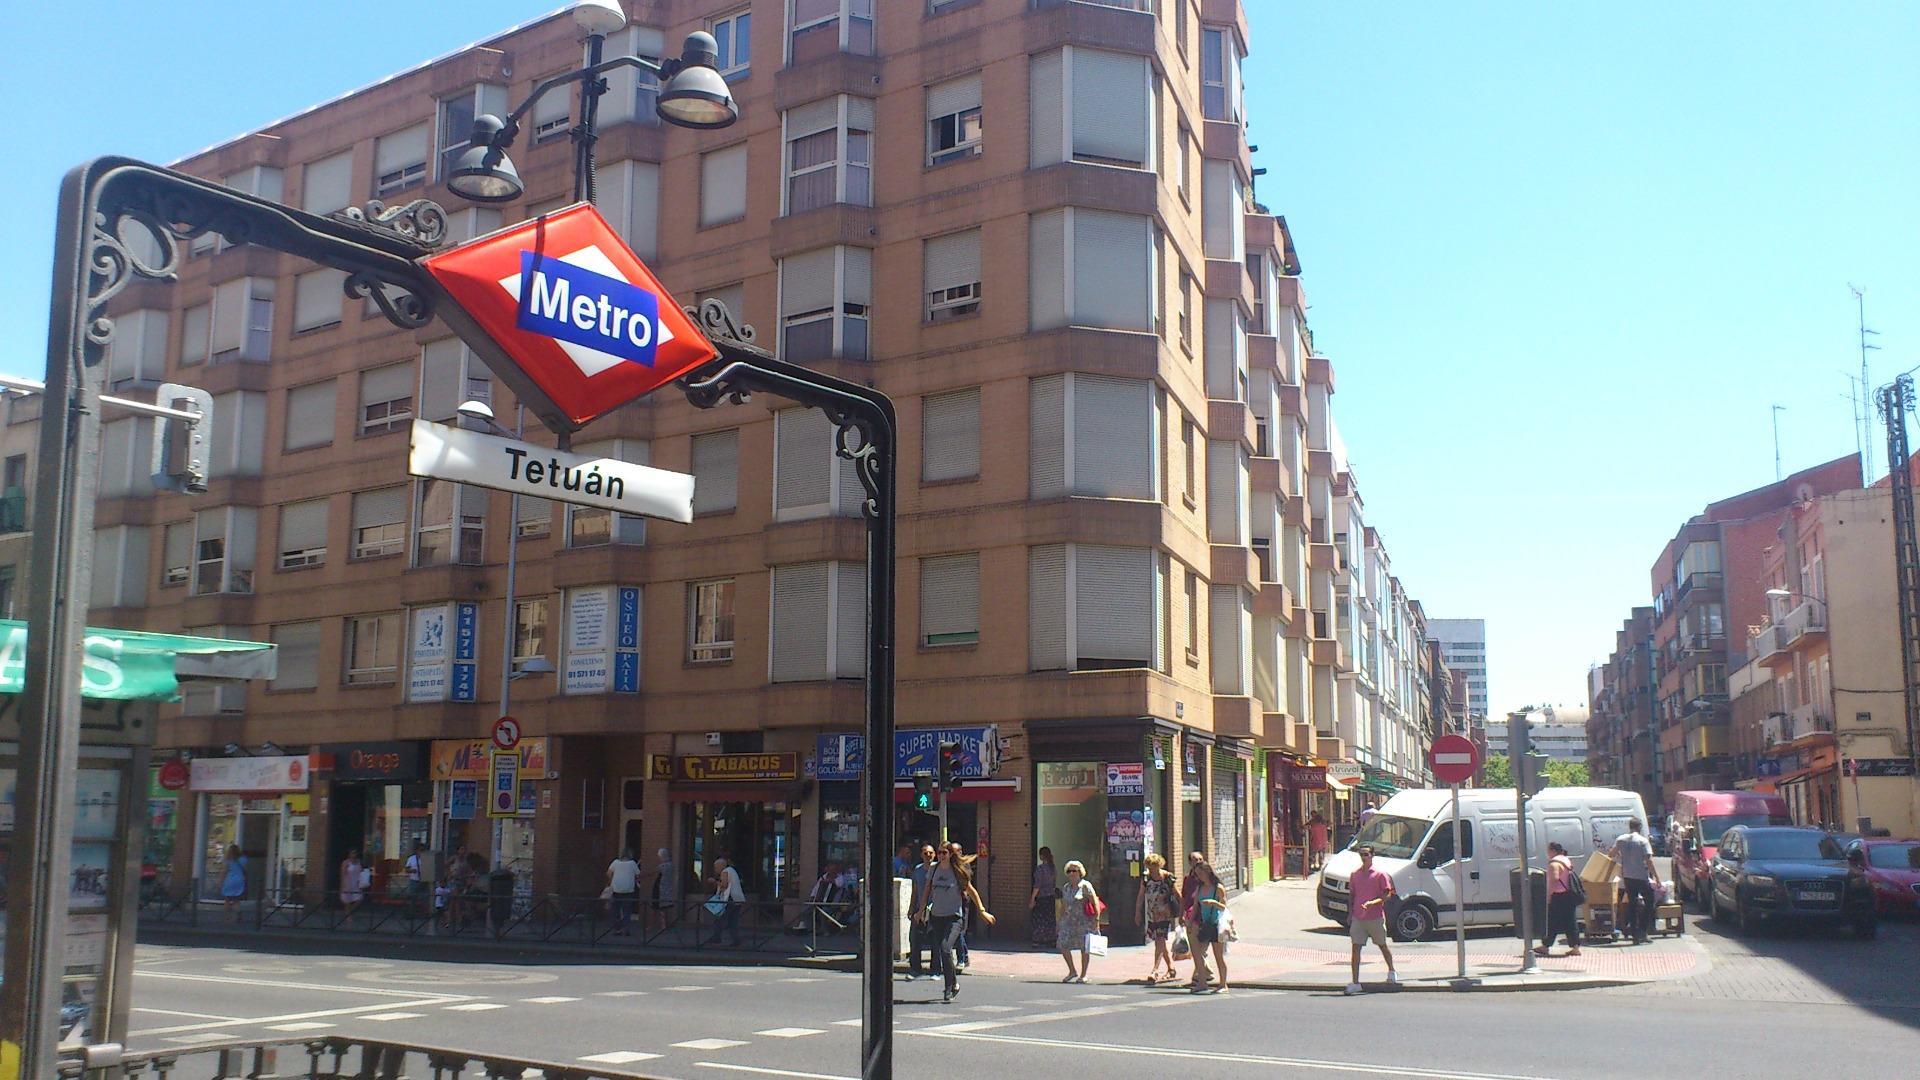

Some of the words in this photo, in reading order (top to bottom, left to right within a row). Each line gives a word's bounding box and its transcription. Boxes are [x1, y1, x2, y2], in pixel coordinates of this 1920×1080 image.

[529, 270, 652, 348] Metro
[504, 447, 625, 500] Tetuán
[622, 590, 635, 645] OSTEO
[620, 653, 632, 690] PATIA
[352, 749, 400, 773] Orange
[710, 756, 781, 771] TABACOS
[899, 733, 934, 758] SUPER
[938, 732, 981, 754] MARKE
